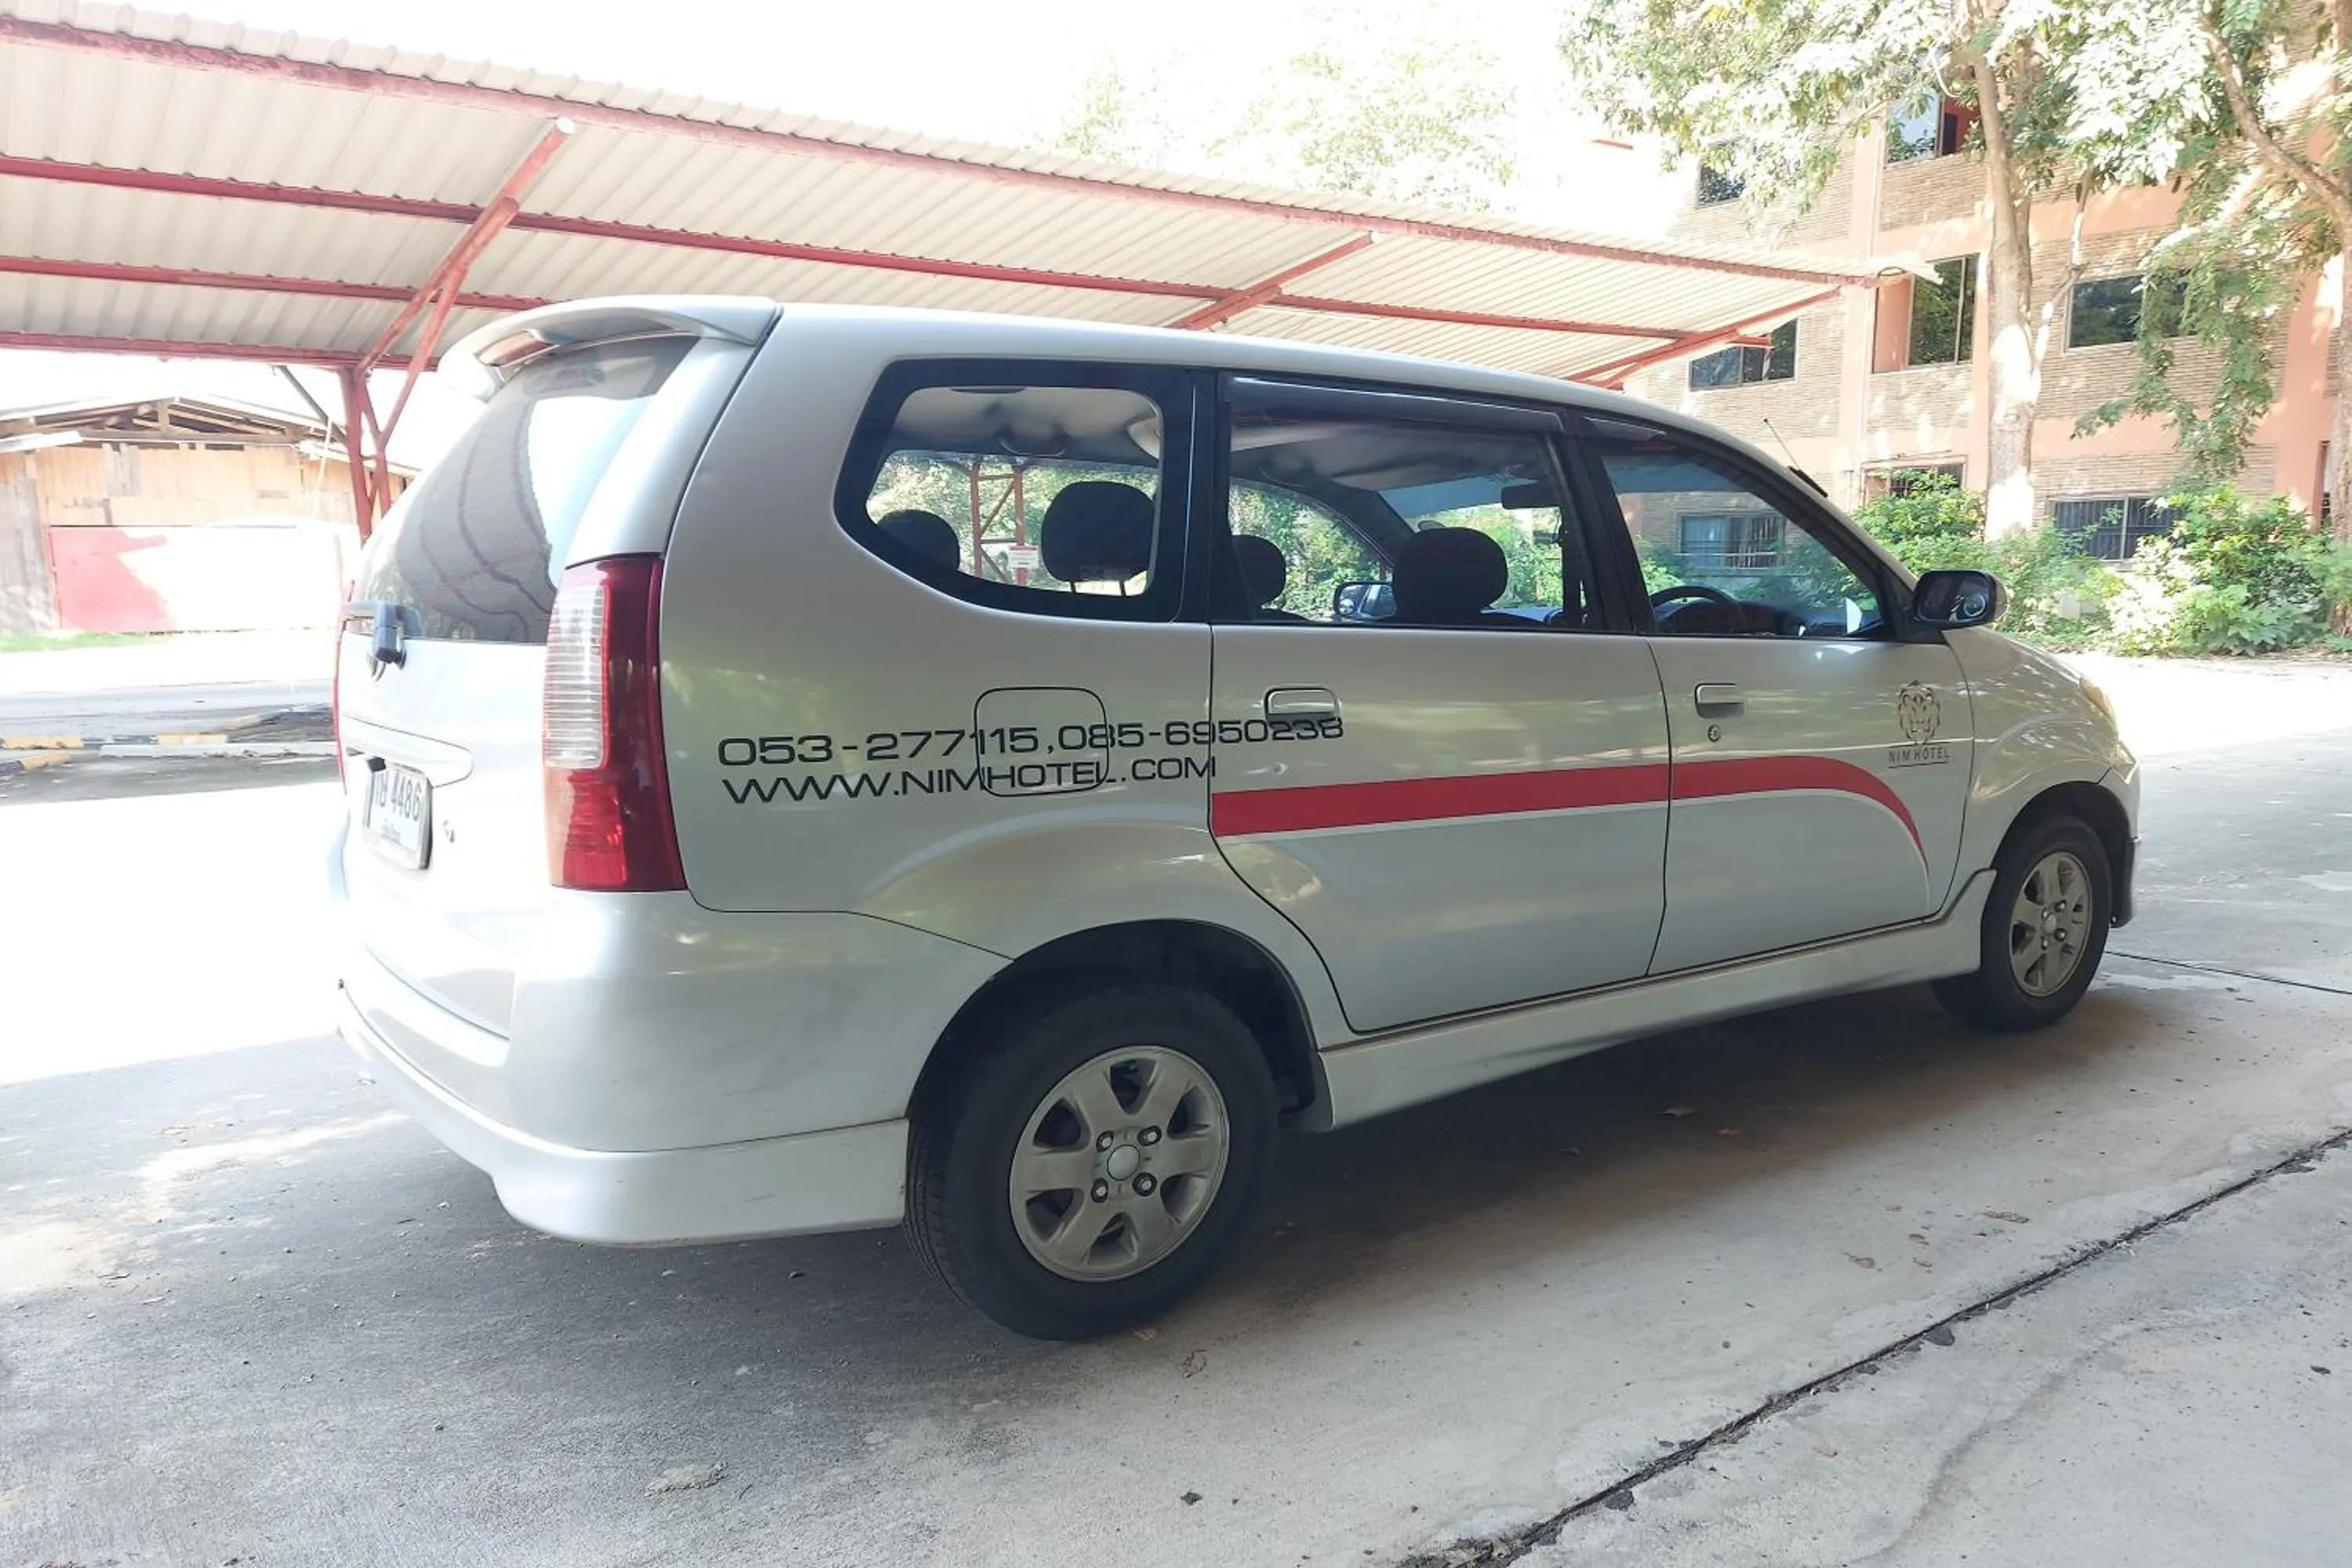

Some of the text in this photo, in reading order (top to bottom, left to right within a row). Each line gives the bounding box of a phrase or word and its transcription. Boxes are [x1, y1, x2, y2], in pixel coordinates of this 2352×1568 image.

[1889, 746, 1951, 764] NIM HOTEL
[390, 771, 423, 822] 4486
[721, 756, 1216, 804] WWW.NIMHOTEL.COM
